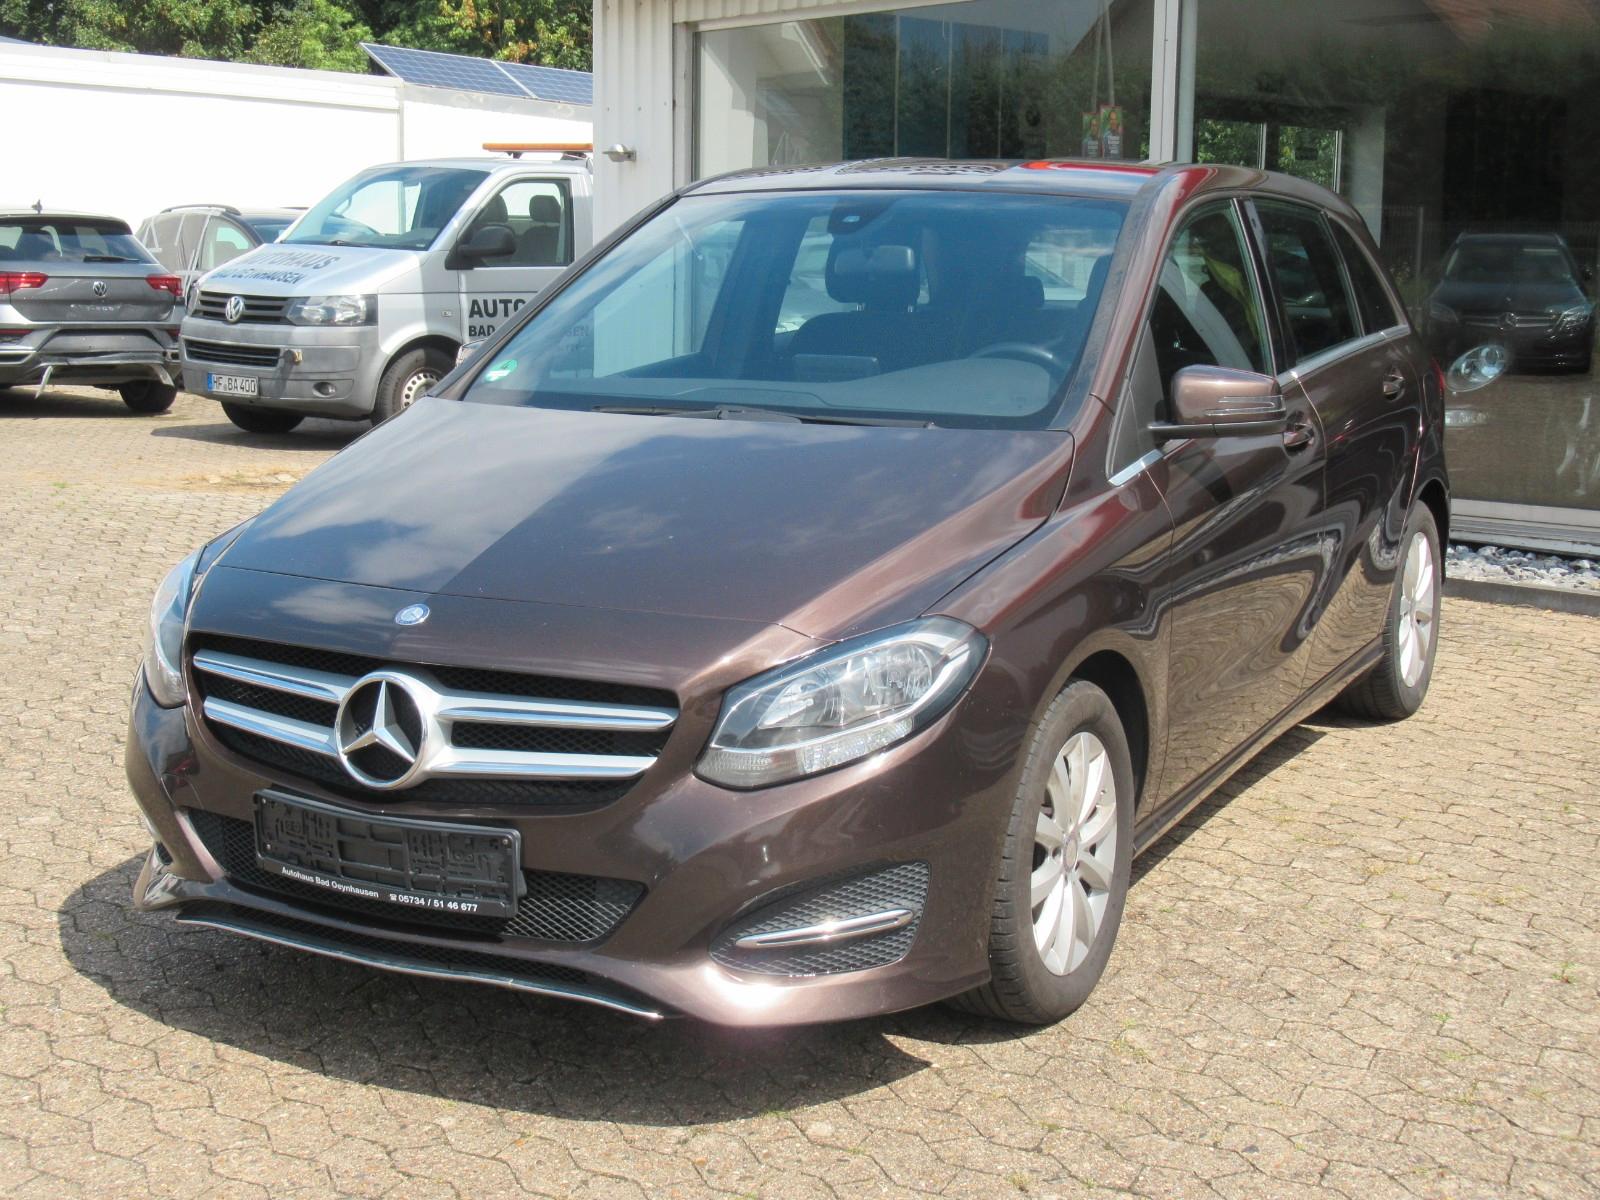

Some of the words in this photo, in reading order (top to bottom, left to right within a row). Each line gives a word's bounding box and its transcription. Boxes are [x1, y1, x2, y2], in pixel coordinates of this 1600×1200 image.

[281, 866, 315, 883] Autohaus
[315, 876, 330, 887] Bad
[331, 881, 379, 898] Oeynhausen
[398, 894, 425, 906] 05734
[433, 899, 444, 909] 51
[447, 901, 459, 910] 46
[460, 903, 478, 912] 677
